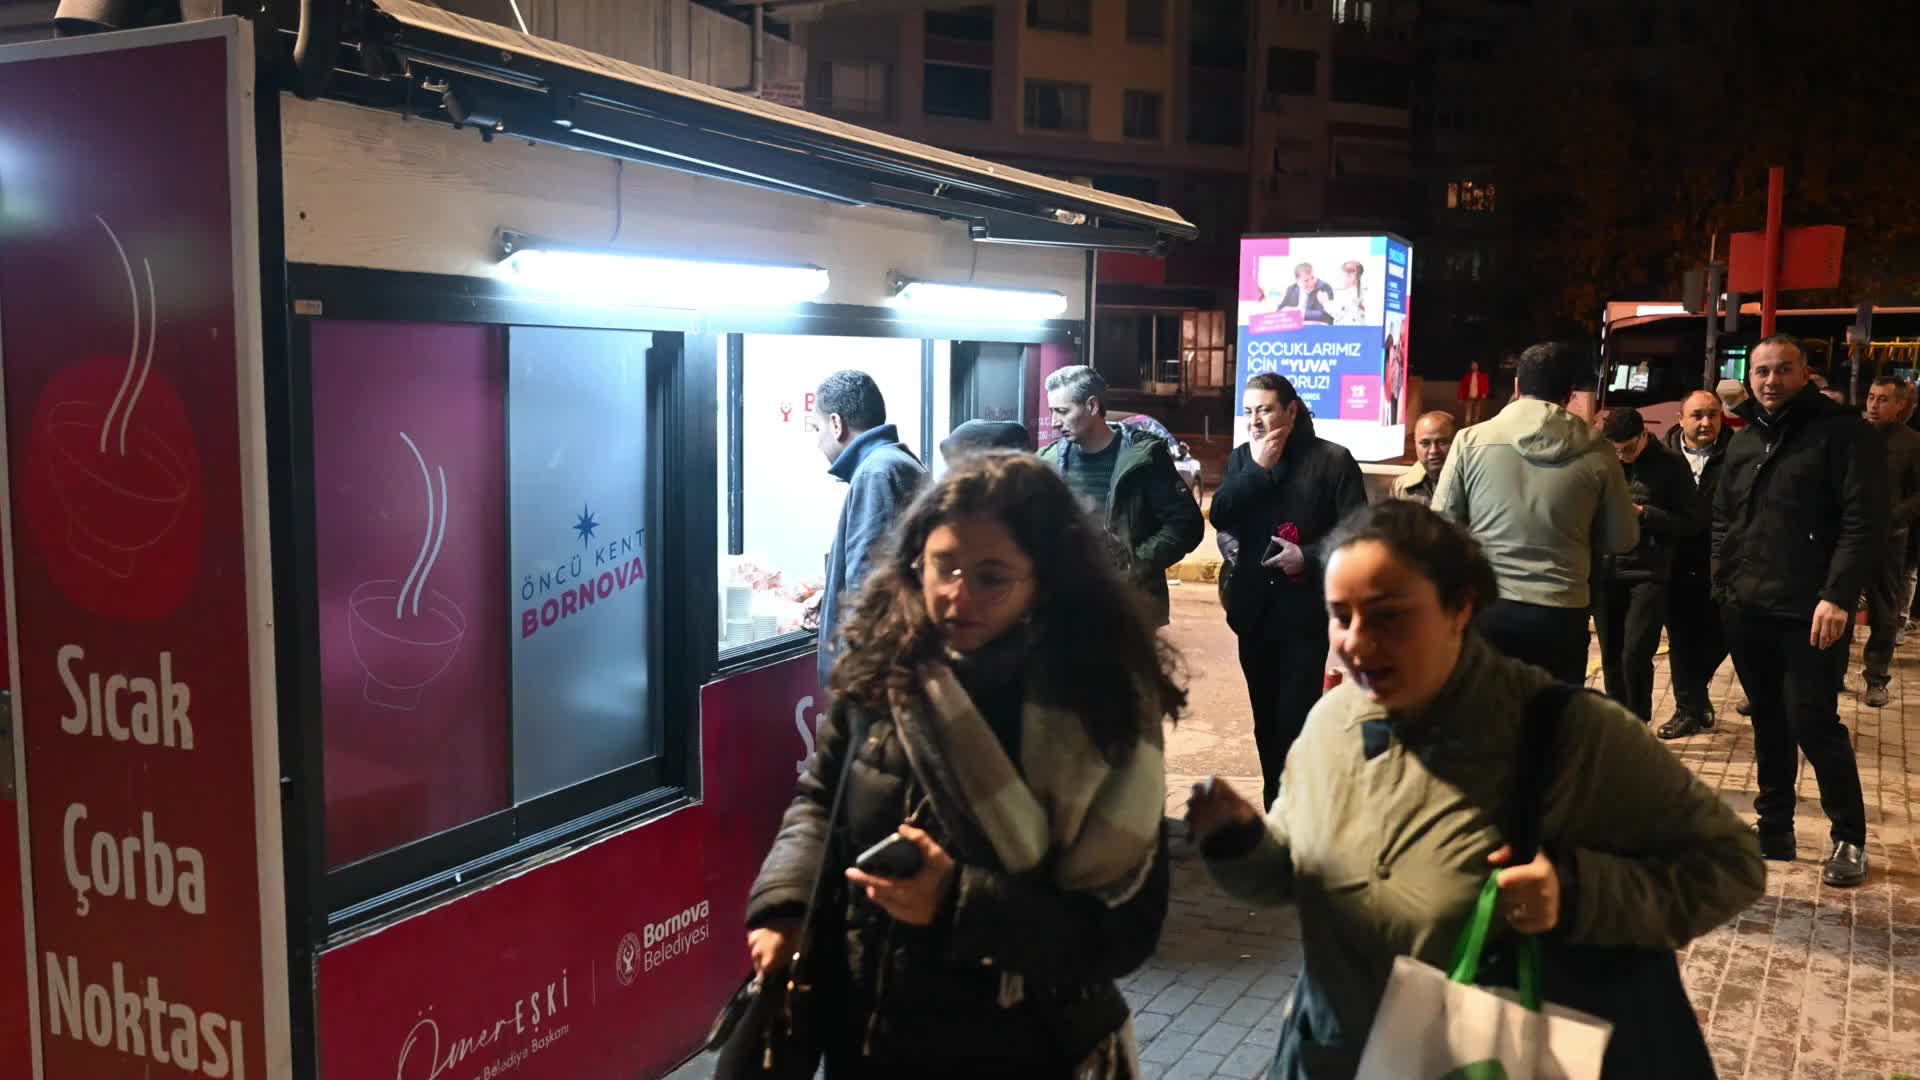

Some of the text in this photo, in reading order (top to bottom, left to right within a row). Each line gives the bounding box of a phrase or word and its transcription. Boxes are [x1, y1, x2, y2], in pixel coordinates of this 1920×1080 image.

[1247, 341, 1361, 357] ÇOCUKLARIMIZ
[521, 556, 645, 639] BORNOVA
[522, 528, 645, 600] ÖNCÜ KENT
[57, 644, 194, 749] Sıcak
[63, 802, 206, 917] Çorba
[643, 900, 709, 949] Bornova
[644, 919, 709, 972] Belediyesi
[45, 951, 246, 1080] Noktası
[483, 1024, 569, 1080] Belediye Başkanı
